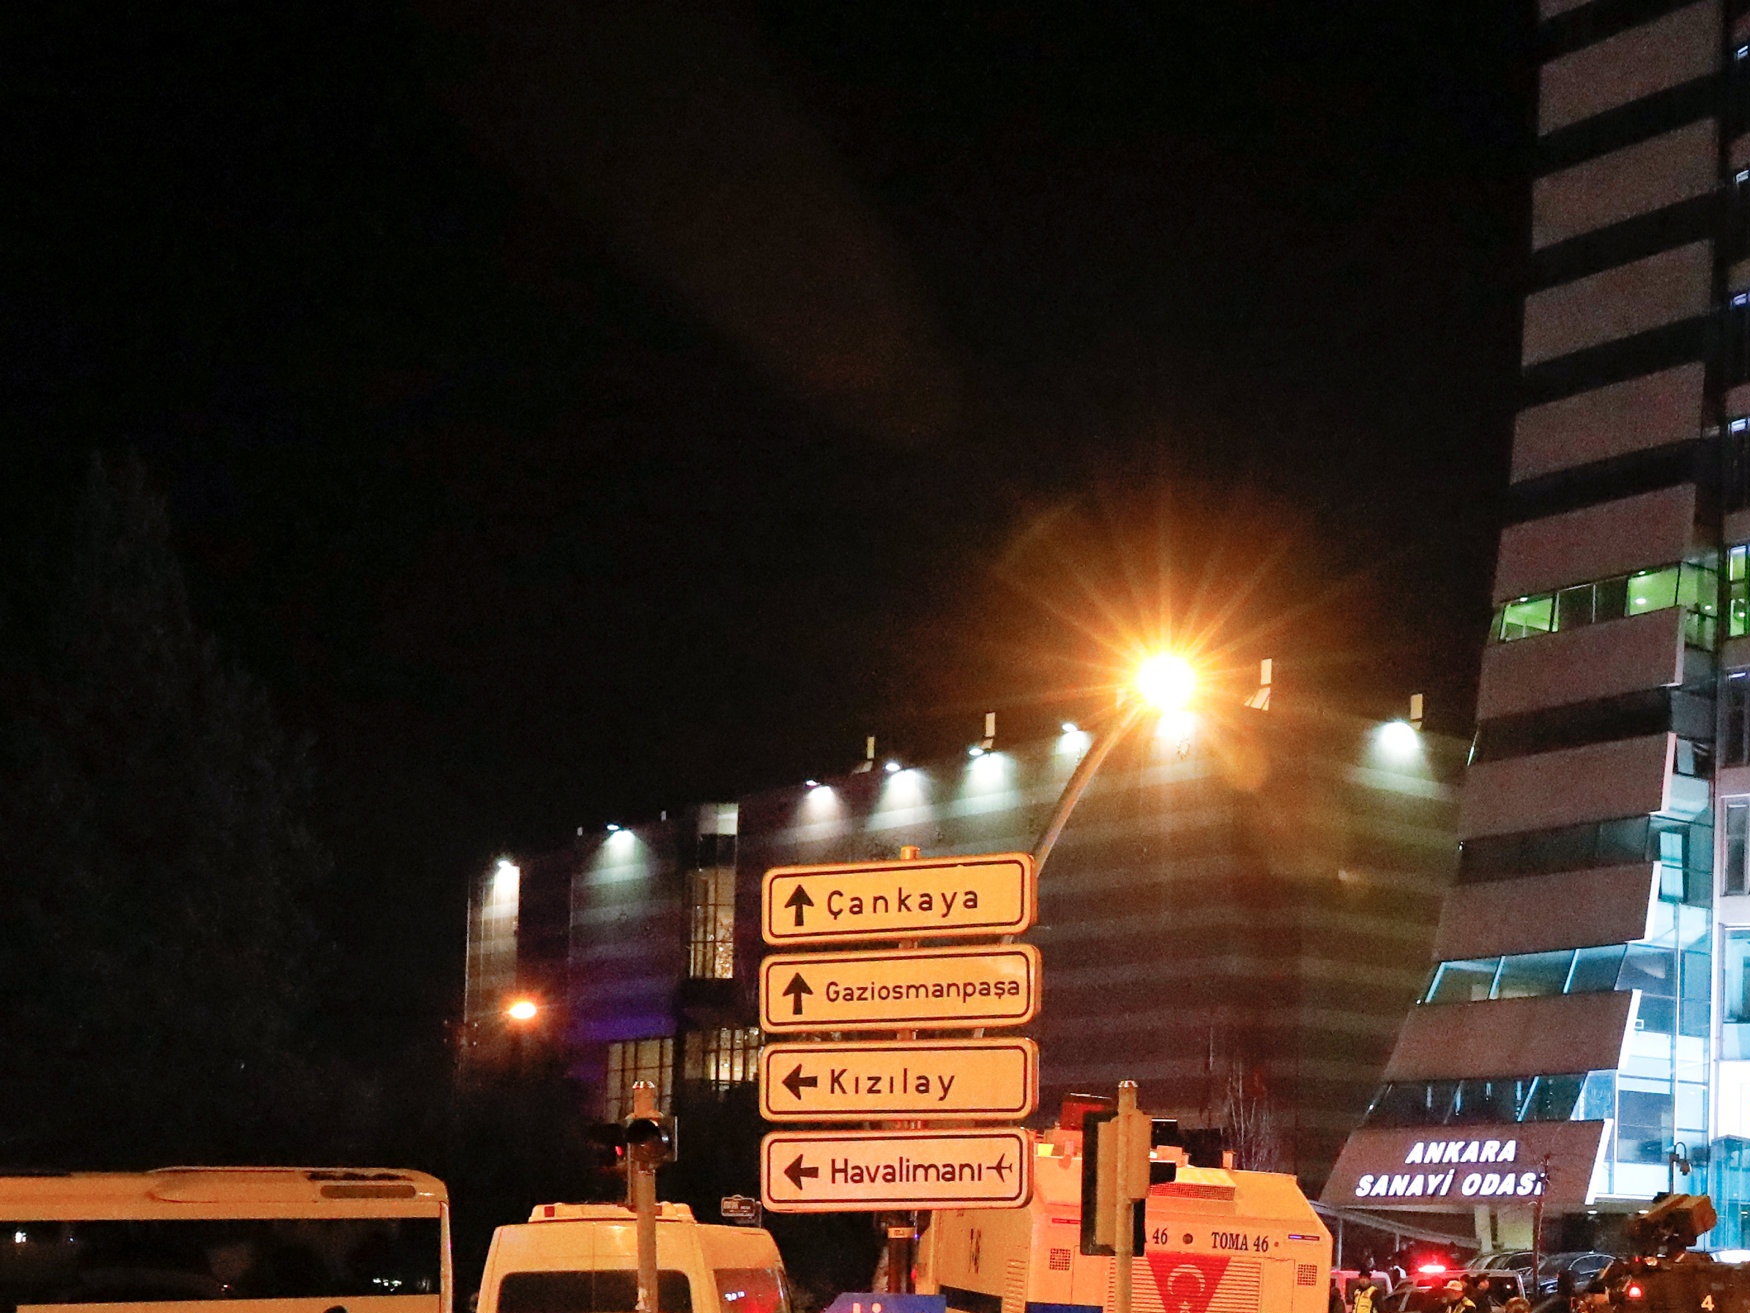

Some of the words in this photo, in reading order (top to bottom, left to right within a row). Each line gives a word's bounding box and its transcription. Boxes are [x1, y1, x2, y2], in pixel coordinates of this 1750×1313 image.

[827, 887, 979, 920] Çankaya
[826, 977, 1020, 1003] Gaziosmanpaşa
[830, 1068, 955, 1100] Kızılay
[1404, 1139, 1517, 1163] ANKARA
[831, 1157, 983, 1184] Havalimanı
[1355, 1168, 1455, 1196] SANAYİ
[1152, 1227, 1168, 1245] 46
[1212, 1231, 1248, 1251] TOMA
[1253, 1235, 1269, 1252] 46
[1701, 1294, 1715, 1311] 4
